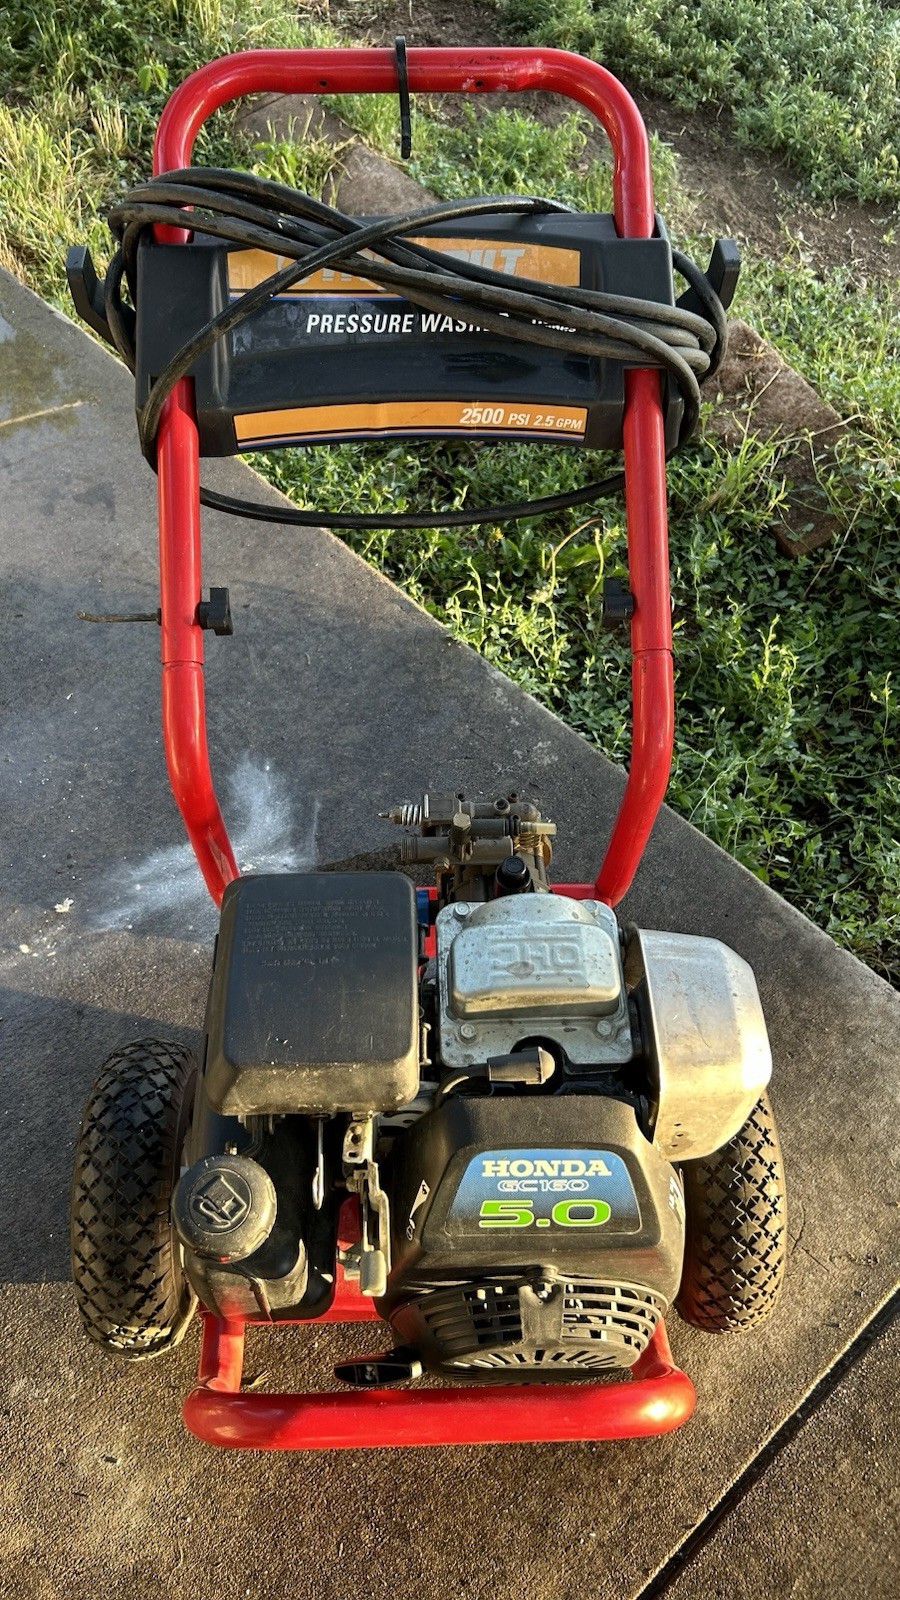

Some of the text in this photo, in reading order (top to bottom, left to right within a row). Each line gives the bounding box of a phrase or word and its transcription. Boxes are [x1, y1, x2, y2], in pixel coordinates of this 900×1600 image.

[306, 314, 414, 333] PRESSURE
[459, 408, 582, 429] 2500 PSI 2.5 GPM
[481, 1159, 612, 1177] HONDA
[497, 1180, 589, 1192] GC160
[479, 1199, 611, 1228] 5.0
